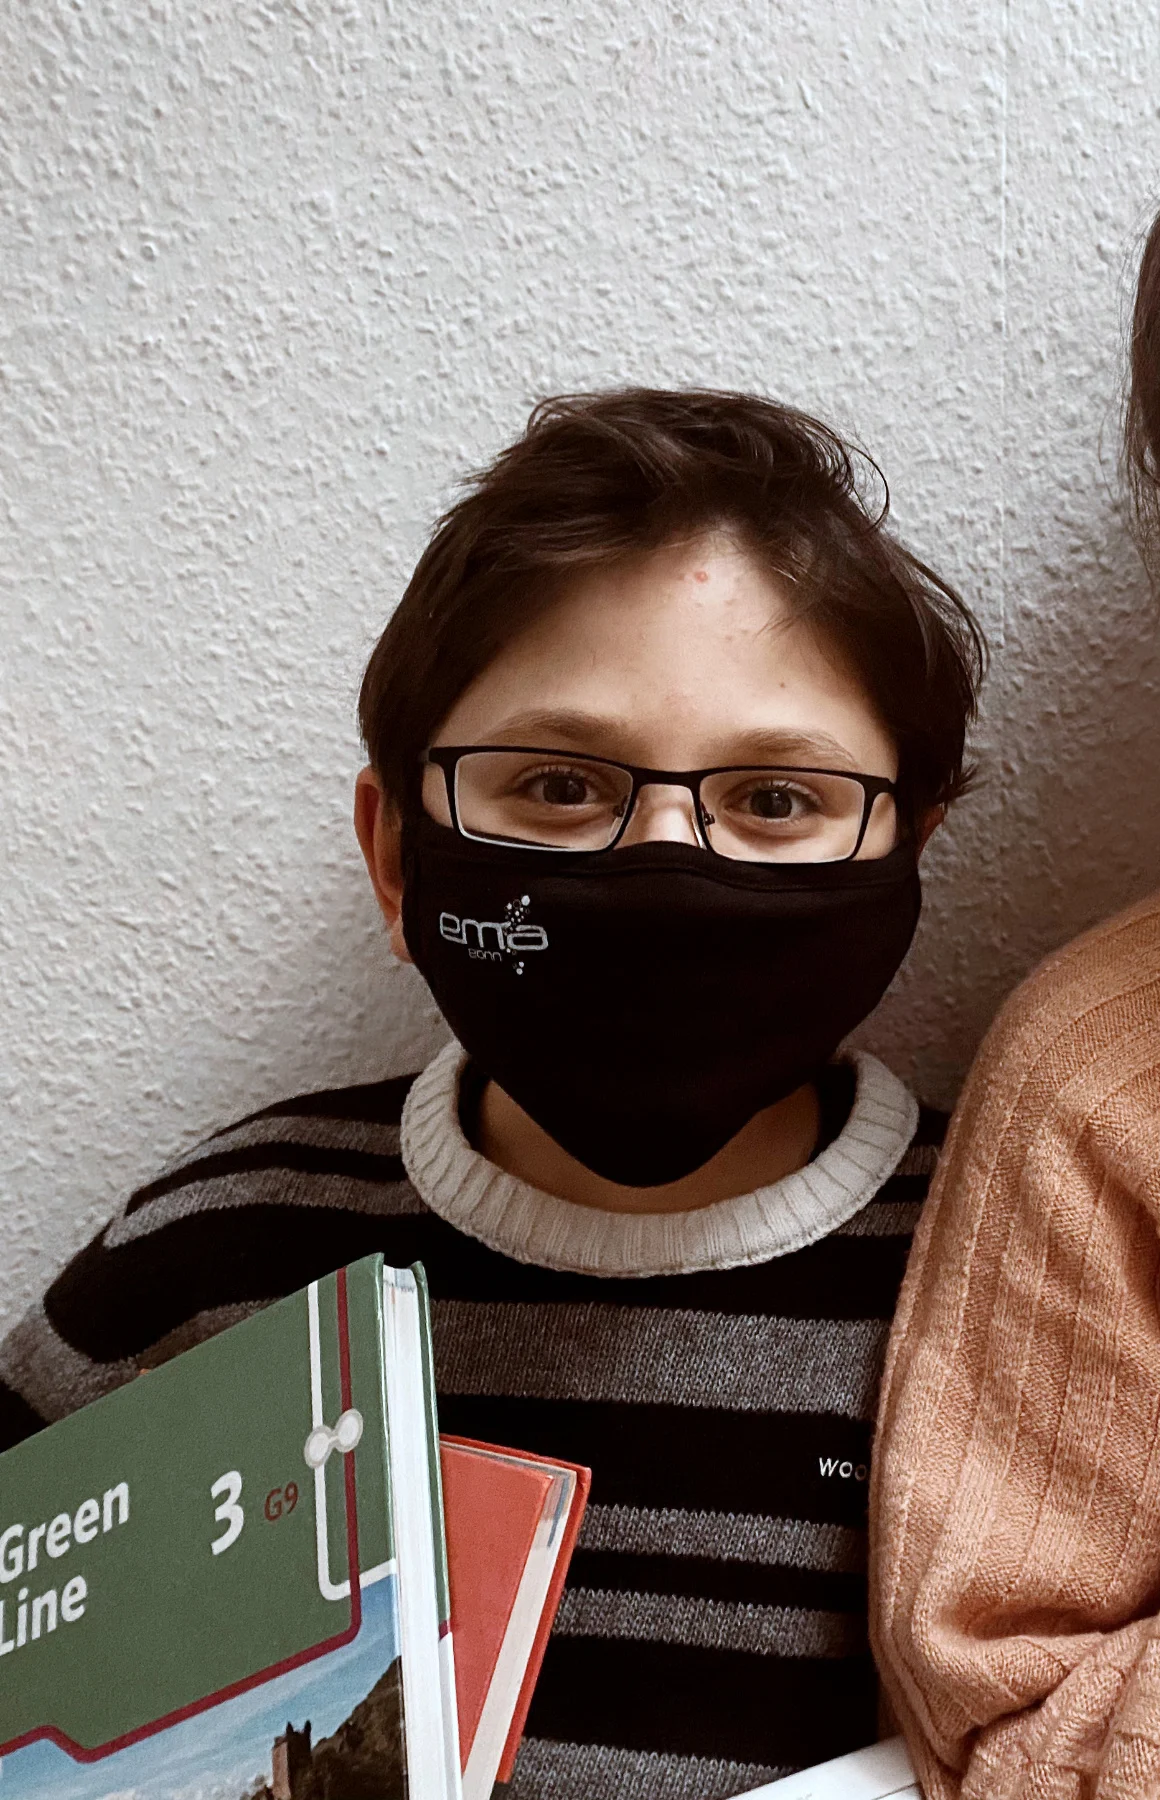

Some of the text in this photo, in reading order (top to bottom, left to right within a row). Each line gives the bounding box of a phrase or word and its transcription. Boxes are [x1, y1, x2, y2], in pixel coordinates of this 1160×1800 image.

[0, 1470, 299, 1584] Green 3 G9
[0, 1575, 88, 1657] Line
